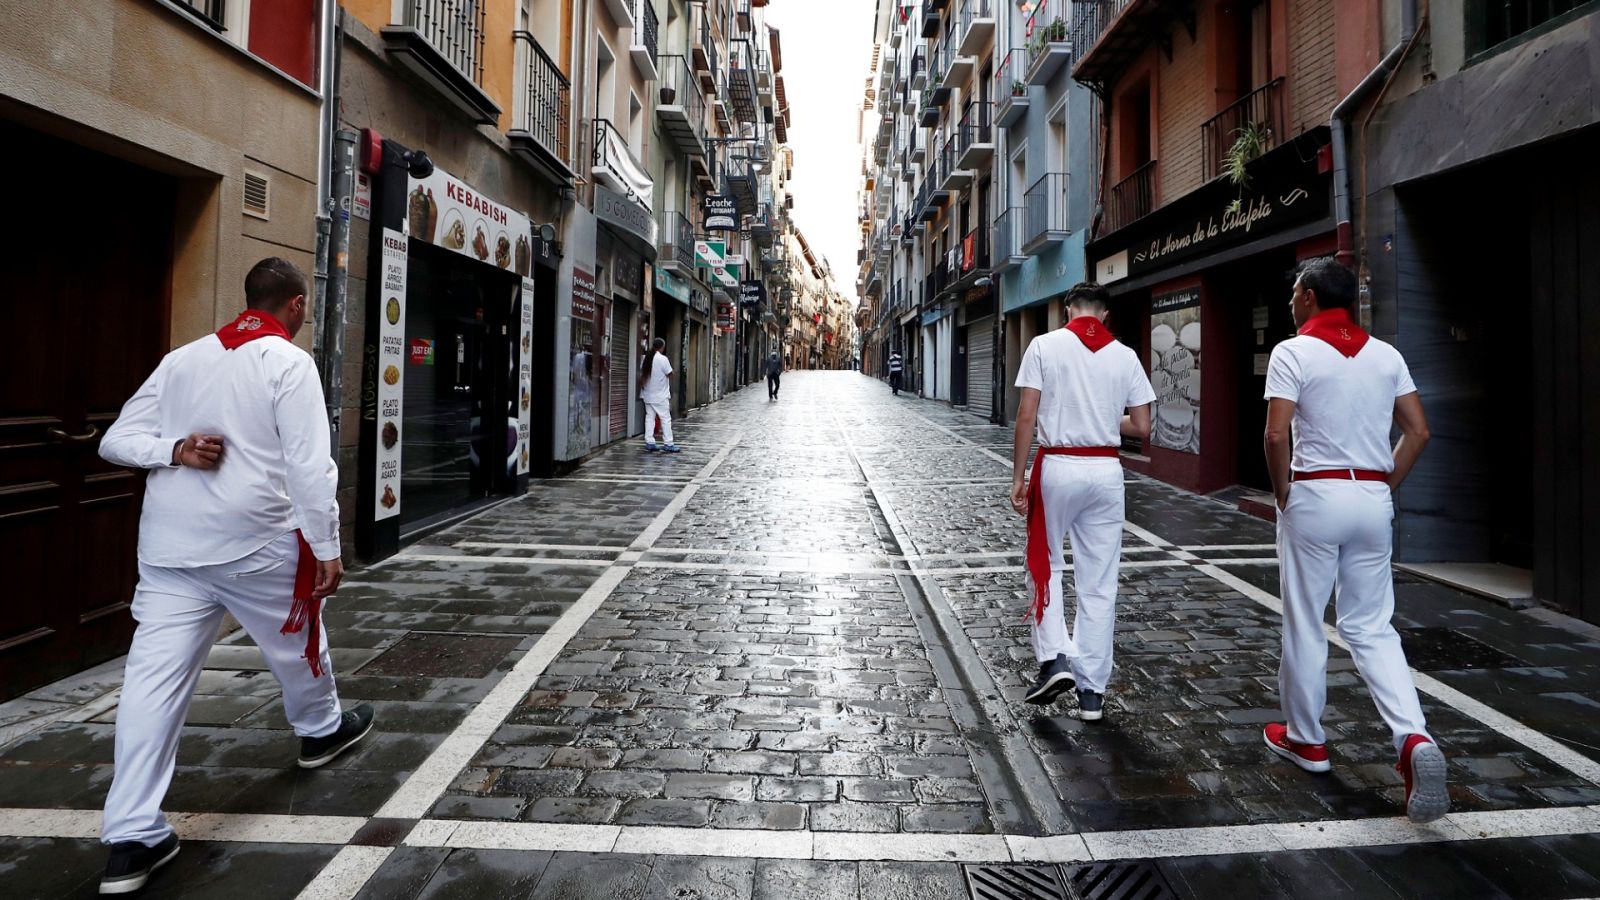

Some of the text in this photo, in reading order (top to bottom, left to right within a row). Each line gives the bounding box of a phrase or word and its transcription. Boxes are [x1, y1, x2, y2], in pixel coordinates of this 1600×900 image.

[447, 181, 507, 226] KEBABISH
[1149, 195, 1272, 260] El Horno de la Estafeta
[384, 236, 407, 253] KEBAB
[387, 264, 402, 276] PLATO
[382, 336, 402, 346] PATATAS
[383, 345, 400, 355] FRITAS
[412, 345, 423, 355] JUST
[383, 399, 398, 409] PLATO
[383, 408, 398, 417] KEBAB
[382, 460, 397, 470] POLLO
[381, 469, 397, 479] ASADO
